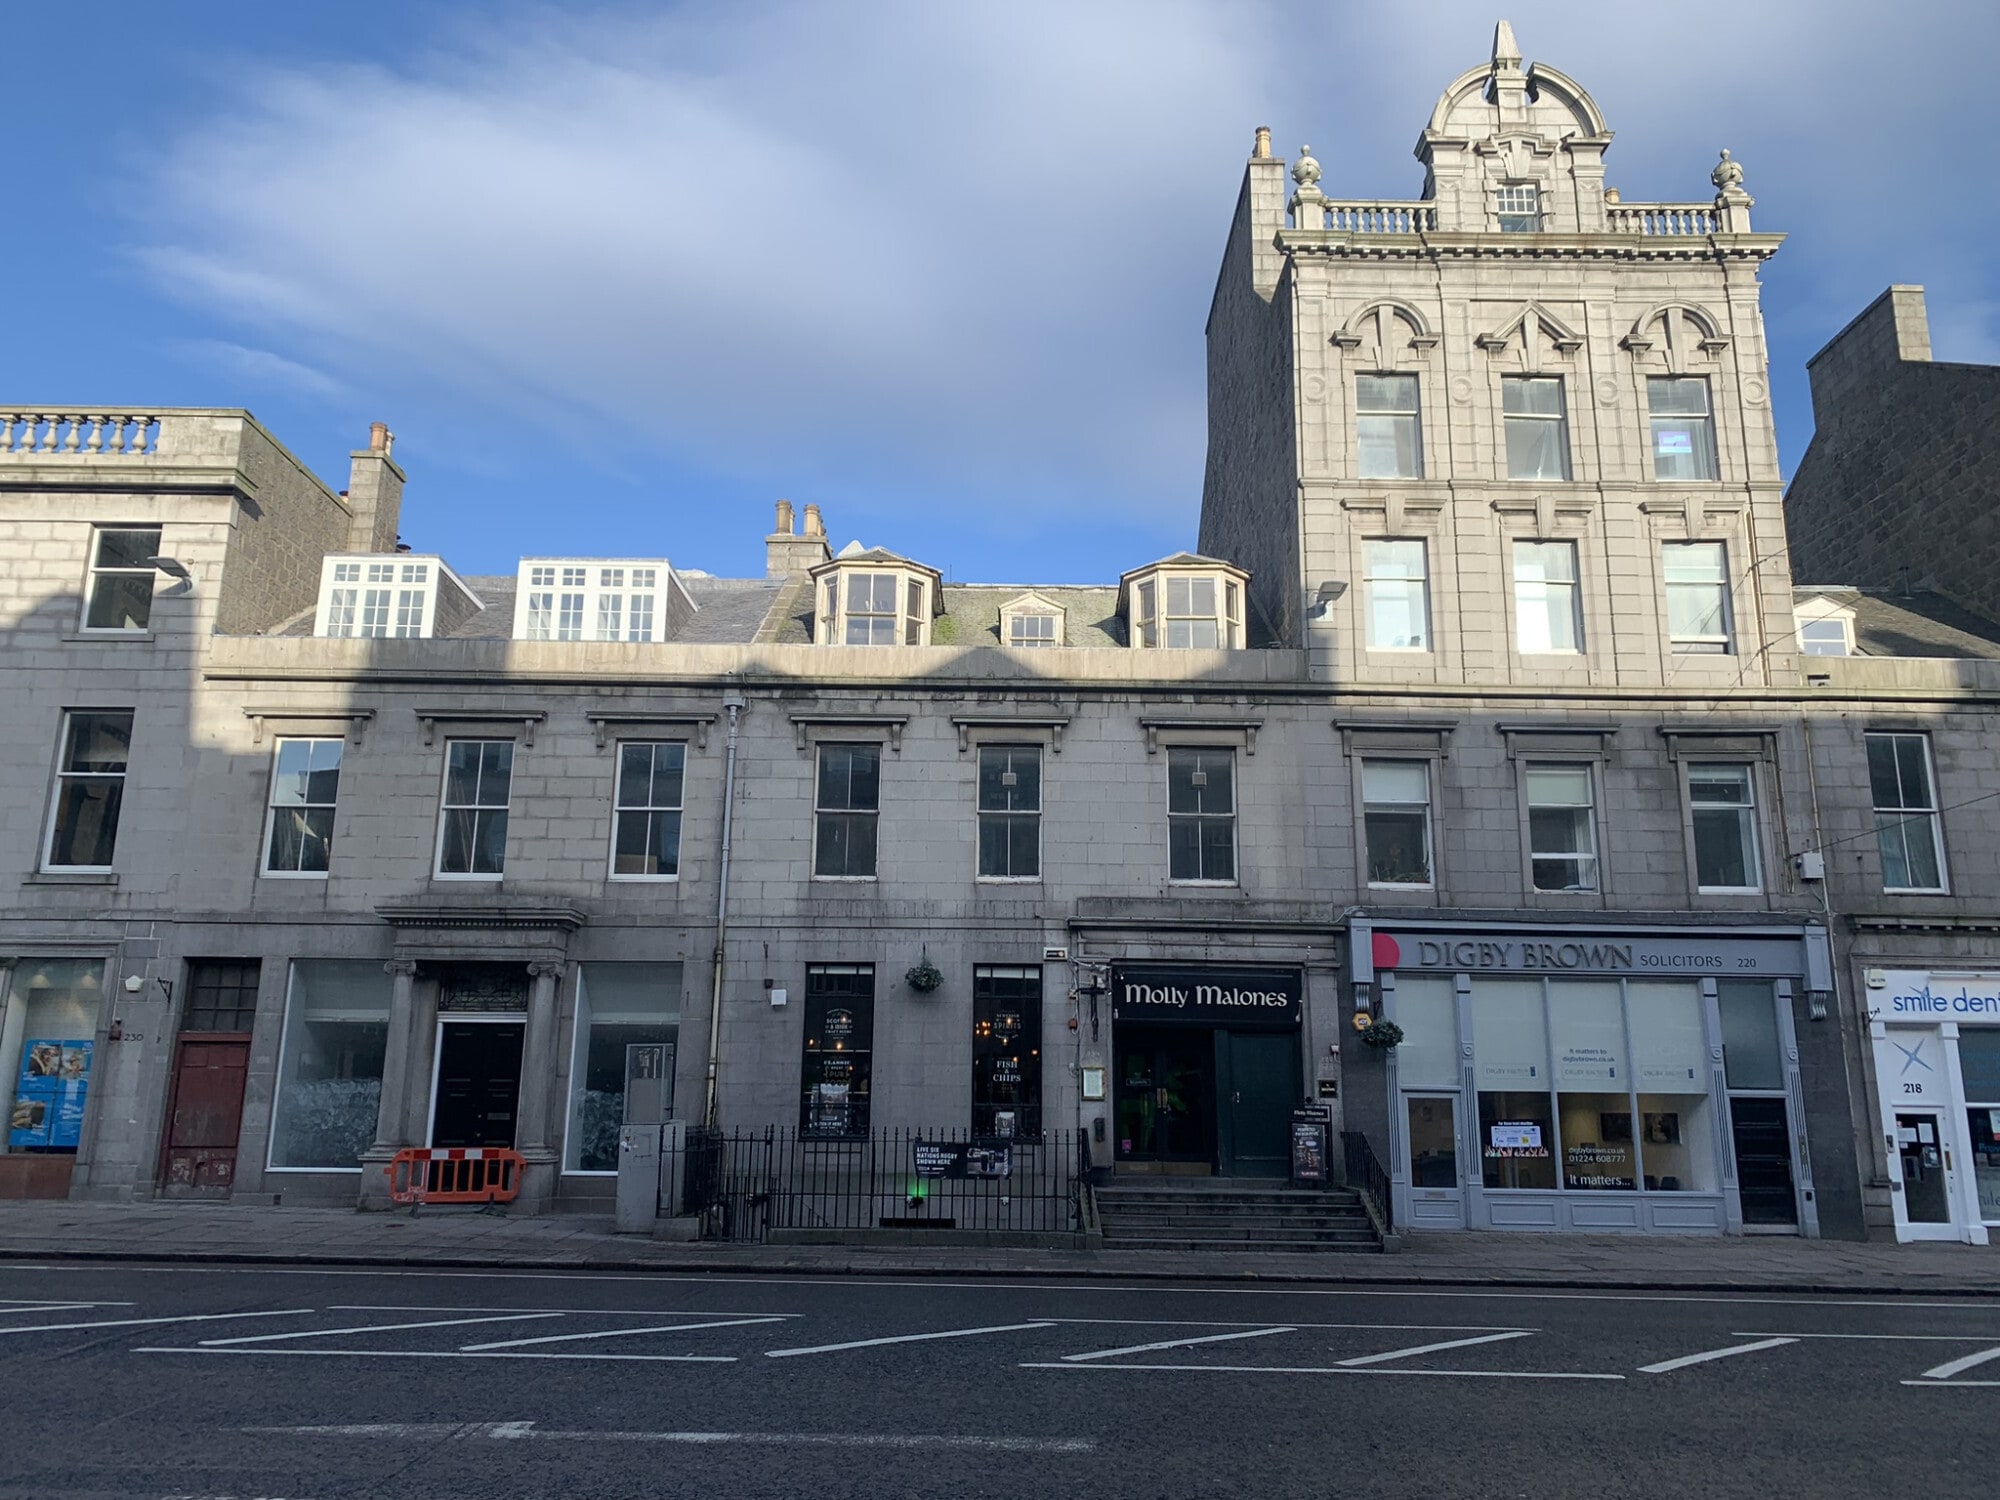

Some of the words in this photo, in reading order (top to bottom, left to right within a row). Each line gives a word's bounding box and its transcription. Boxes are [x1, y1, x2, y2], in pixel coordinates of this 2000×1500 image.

[1417, 941, 1514, 968] DIGBY
[1521, 942, 1634, 970] BROWN
[1639, 954, 1723, 968] SOLICITORS
[1737, 957, 1757, 968] 220
[1125, 983, 1189, 1008] Molly
[1195, 985, 1288, 1007] Malones
[1893, 985, 1948, 1012] smile
[1952, 986, 2000, 1012] den
[124, 1033, 144, 1042] 230
[993, 1074, 1022, 1082] CHIPS
[1903, 1083, 1923, 1094] 218
[1568, 1147, 1625, 1156] digbybrown.co.uk
[1570, 1174, 1577, 1185] It
